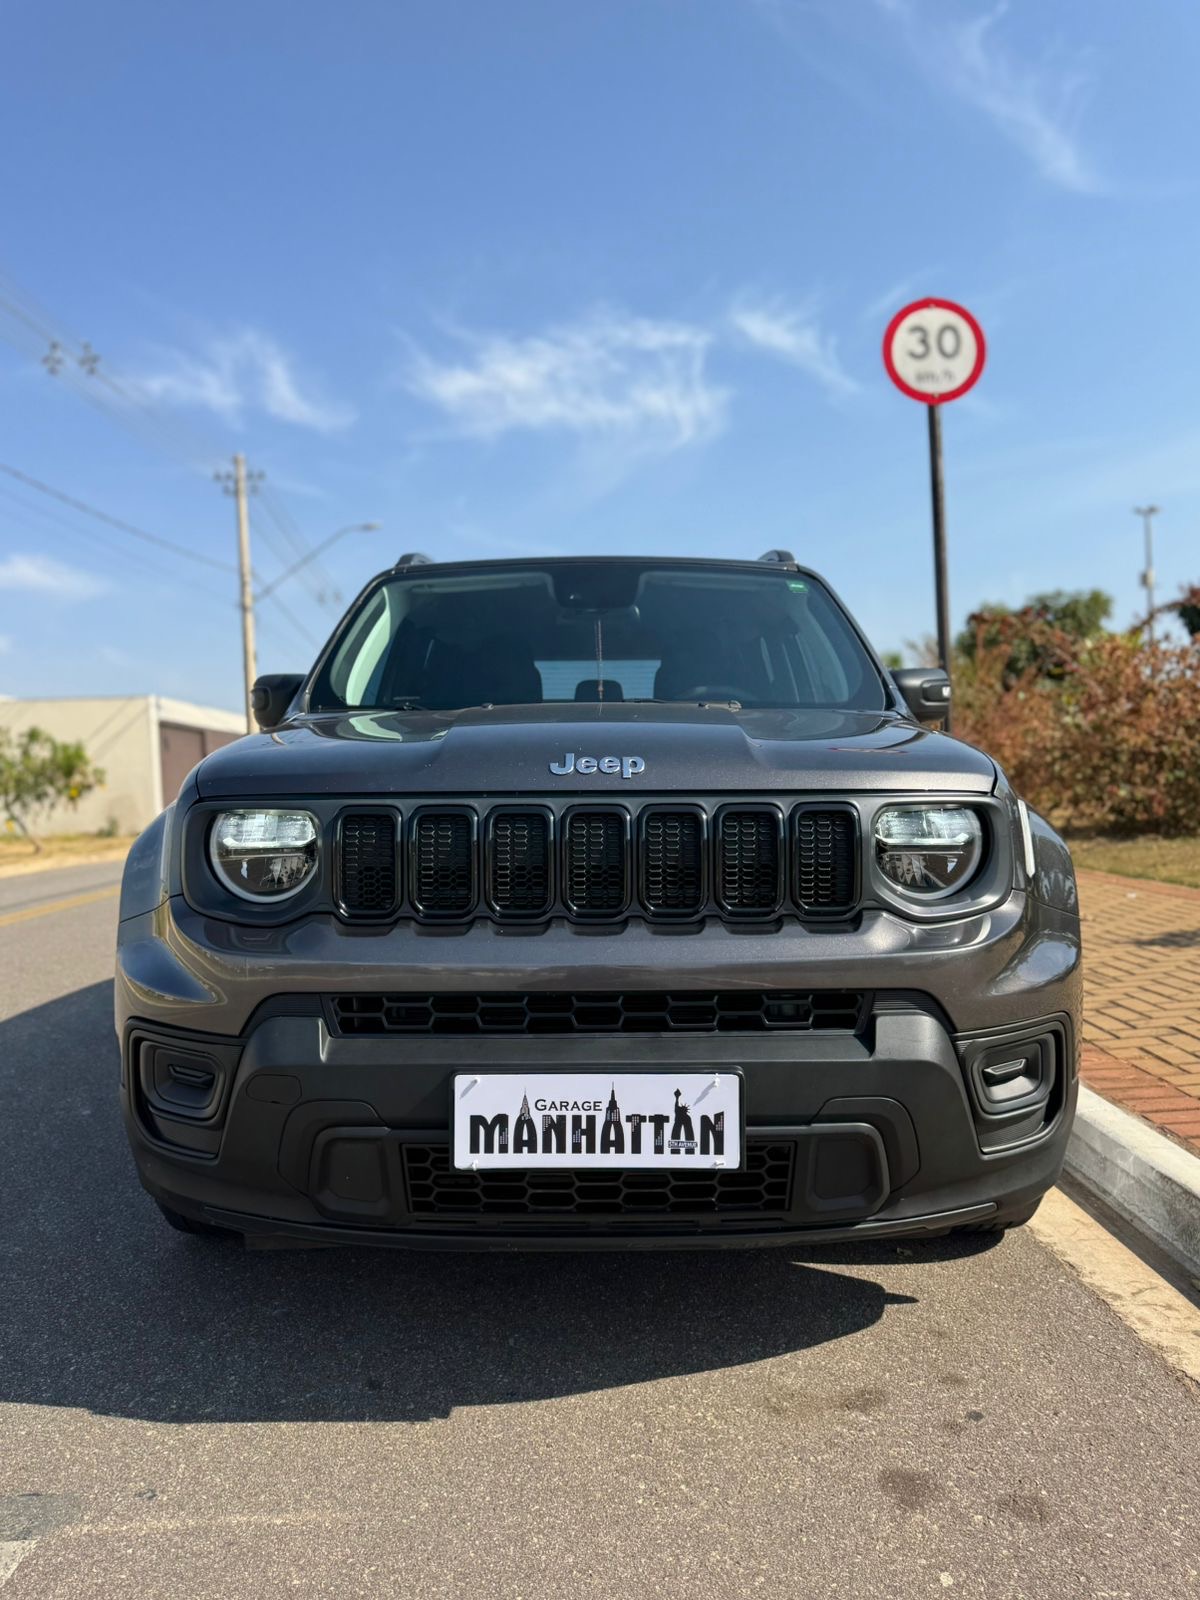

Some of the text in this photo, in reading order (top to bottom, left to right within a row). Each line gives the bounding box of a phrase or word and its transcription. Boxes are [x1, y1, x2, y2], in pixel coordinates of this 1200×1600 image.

[907, 324, 962, 360] 30
[549, 752, 646, 779] Jeep
[469, 1109, 725, 1155] MANHATTAN
